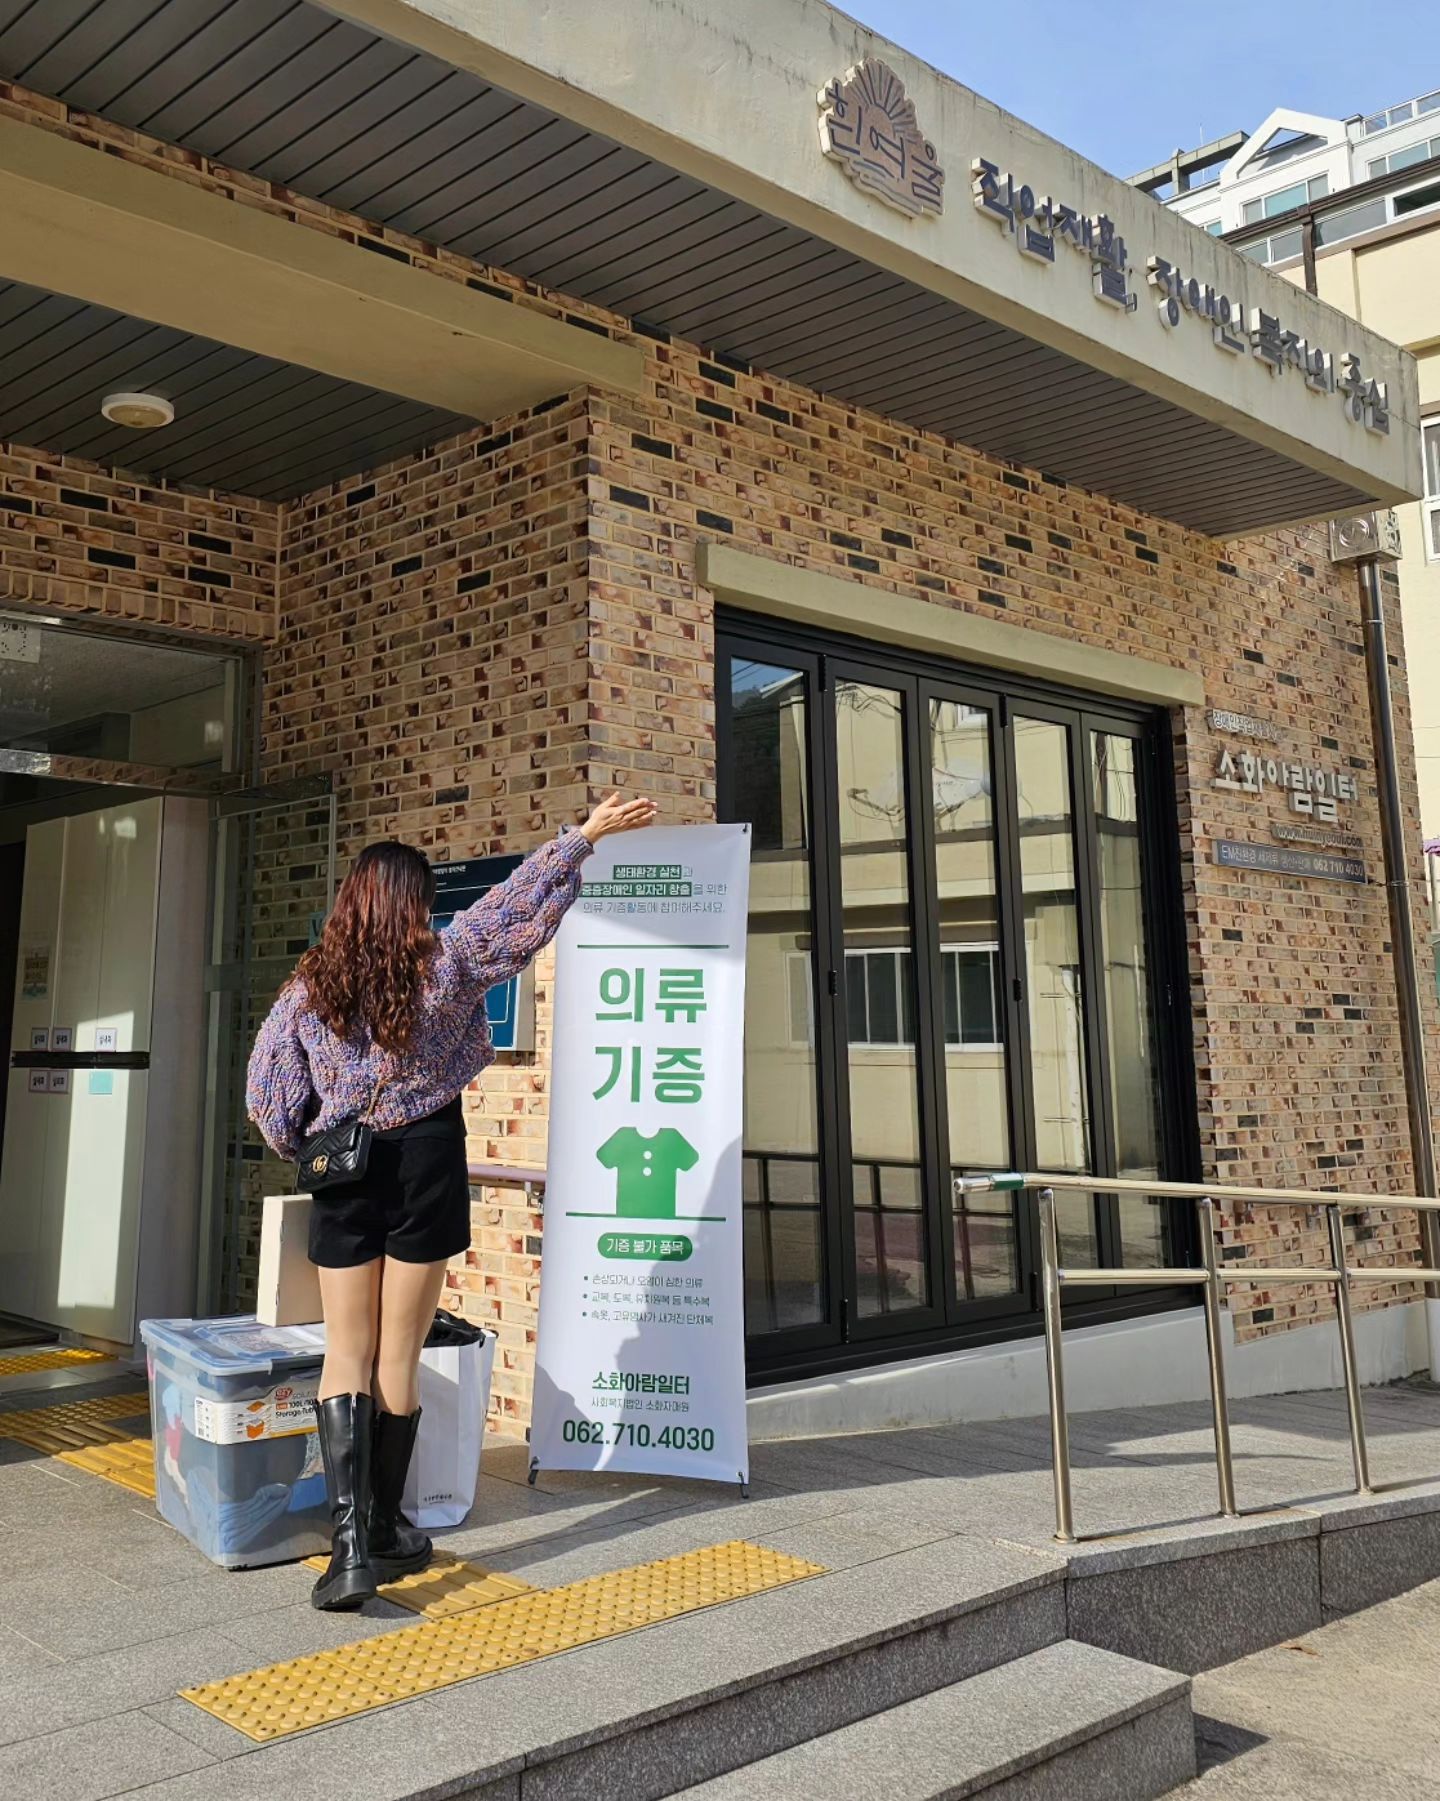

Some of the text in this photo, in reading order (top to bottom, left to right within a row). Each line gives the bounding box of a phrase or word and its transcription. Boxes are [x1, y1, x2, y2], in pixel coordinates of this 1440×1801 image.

[826, 81, 943, 207] 흰여울
[1148, 255, 1246, 356] 장애인
[1251, 307, 1337, 396] 복지의
[1340, 353, 1390, 436] 중심
[1211, 749, 1359, 824] 소화아람일터
[614, 866, 657, 879] 생태환경
[635, 884, 666, 896] 일자리
[706, 884, 727, 896] 위한
[583, 902, 603, 914] 의류
[607, 902, 657, 914] 기증활동에
[595, 967, 708, 1024] 의류
[592, 1045, 706, 1104] 기증
[606, 1238, 684, 1255] 기증 불가 품목
[592, 1274, 635, 1286] 손상되거나
[665, 1276, 683, 1288] 심한
[685, 1278, 704, 1289] 의류
[686, 1314, 714, 1325] 단체복
[591, 1371, 690, 1395] 소화아람일터
[591, 1397, 690, 1412] 사회복지법인 소화자매원
[562, 1418, 715, 1452] 062.710.4030
